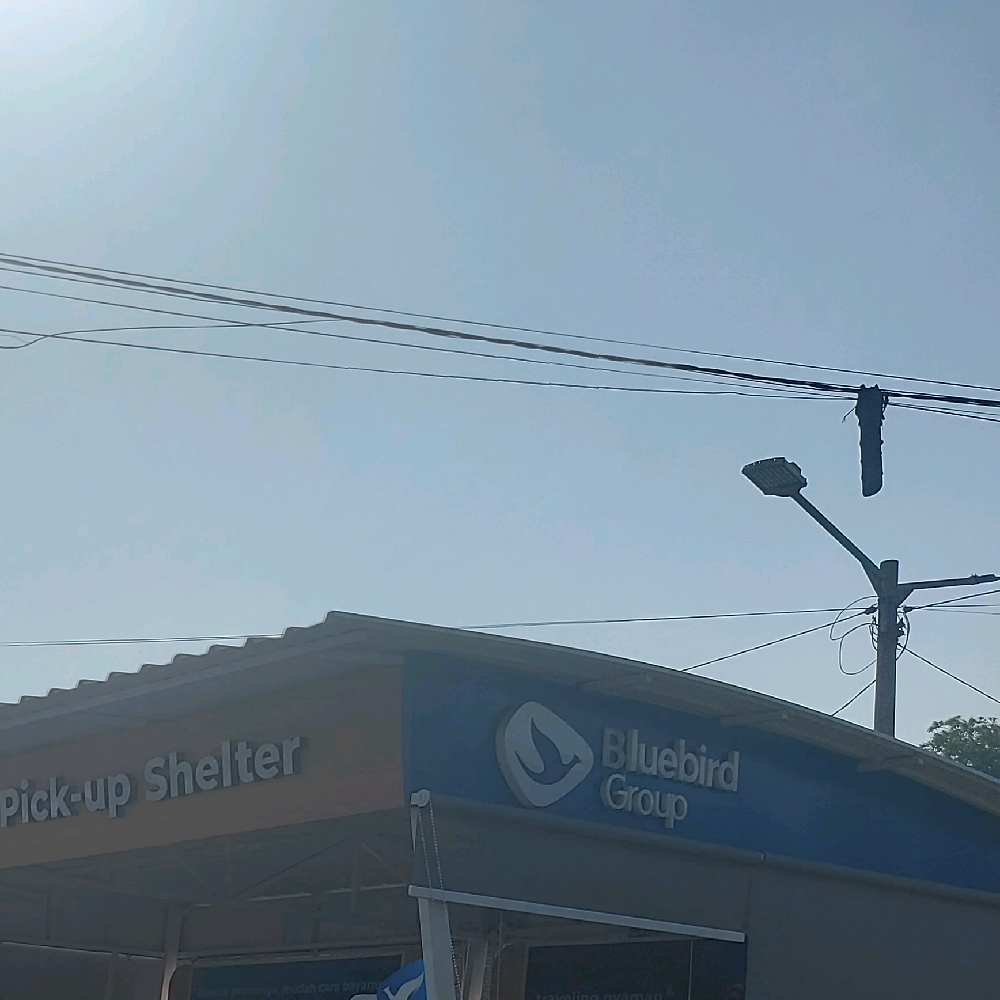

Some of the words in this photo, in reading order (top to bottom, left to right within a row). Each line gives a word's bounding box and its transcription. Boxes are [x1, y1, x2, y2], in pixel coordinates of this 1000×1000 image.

[0, 772, 133, 828] Pick-up
[144, 736, 304, 802] Shelter
[602, 728, 739, 792] Bluebird
[600, 773, 688, 829] Group
